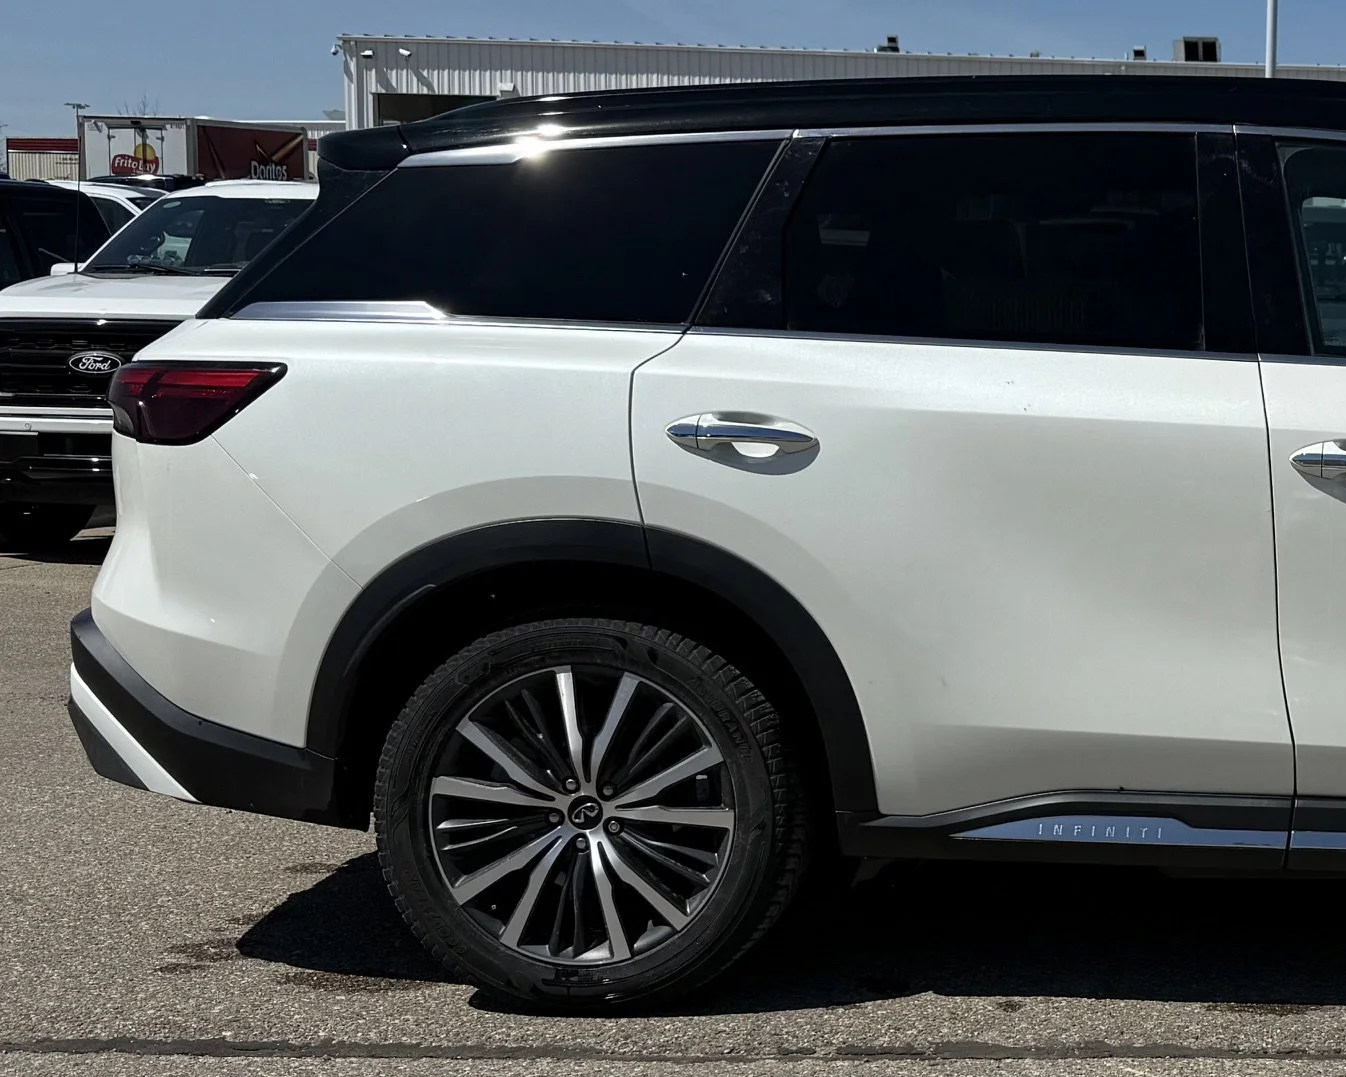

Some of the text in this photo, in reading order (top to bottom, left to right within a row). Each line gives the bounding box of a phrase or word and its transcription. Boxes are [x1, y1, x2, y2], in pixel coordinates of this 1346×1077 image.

[115, 157, 138, 169] Frito
[251, 160, 288, 180] Doritos
[79, 357, 112, 370] Ford
[1038, 823, 1162, 839] INFINITI
